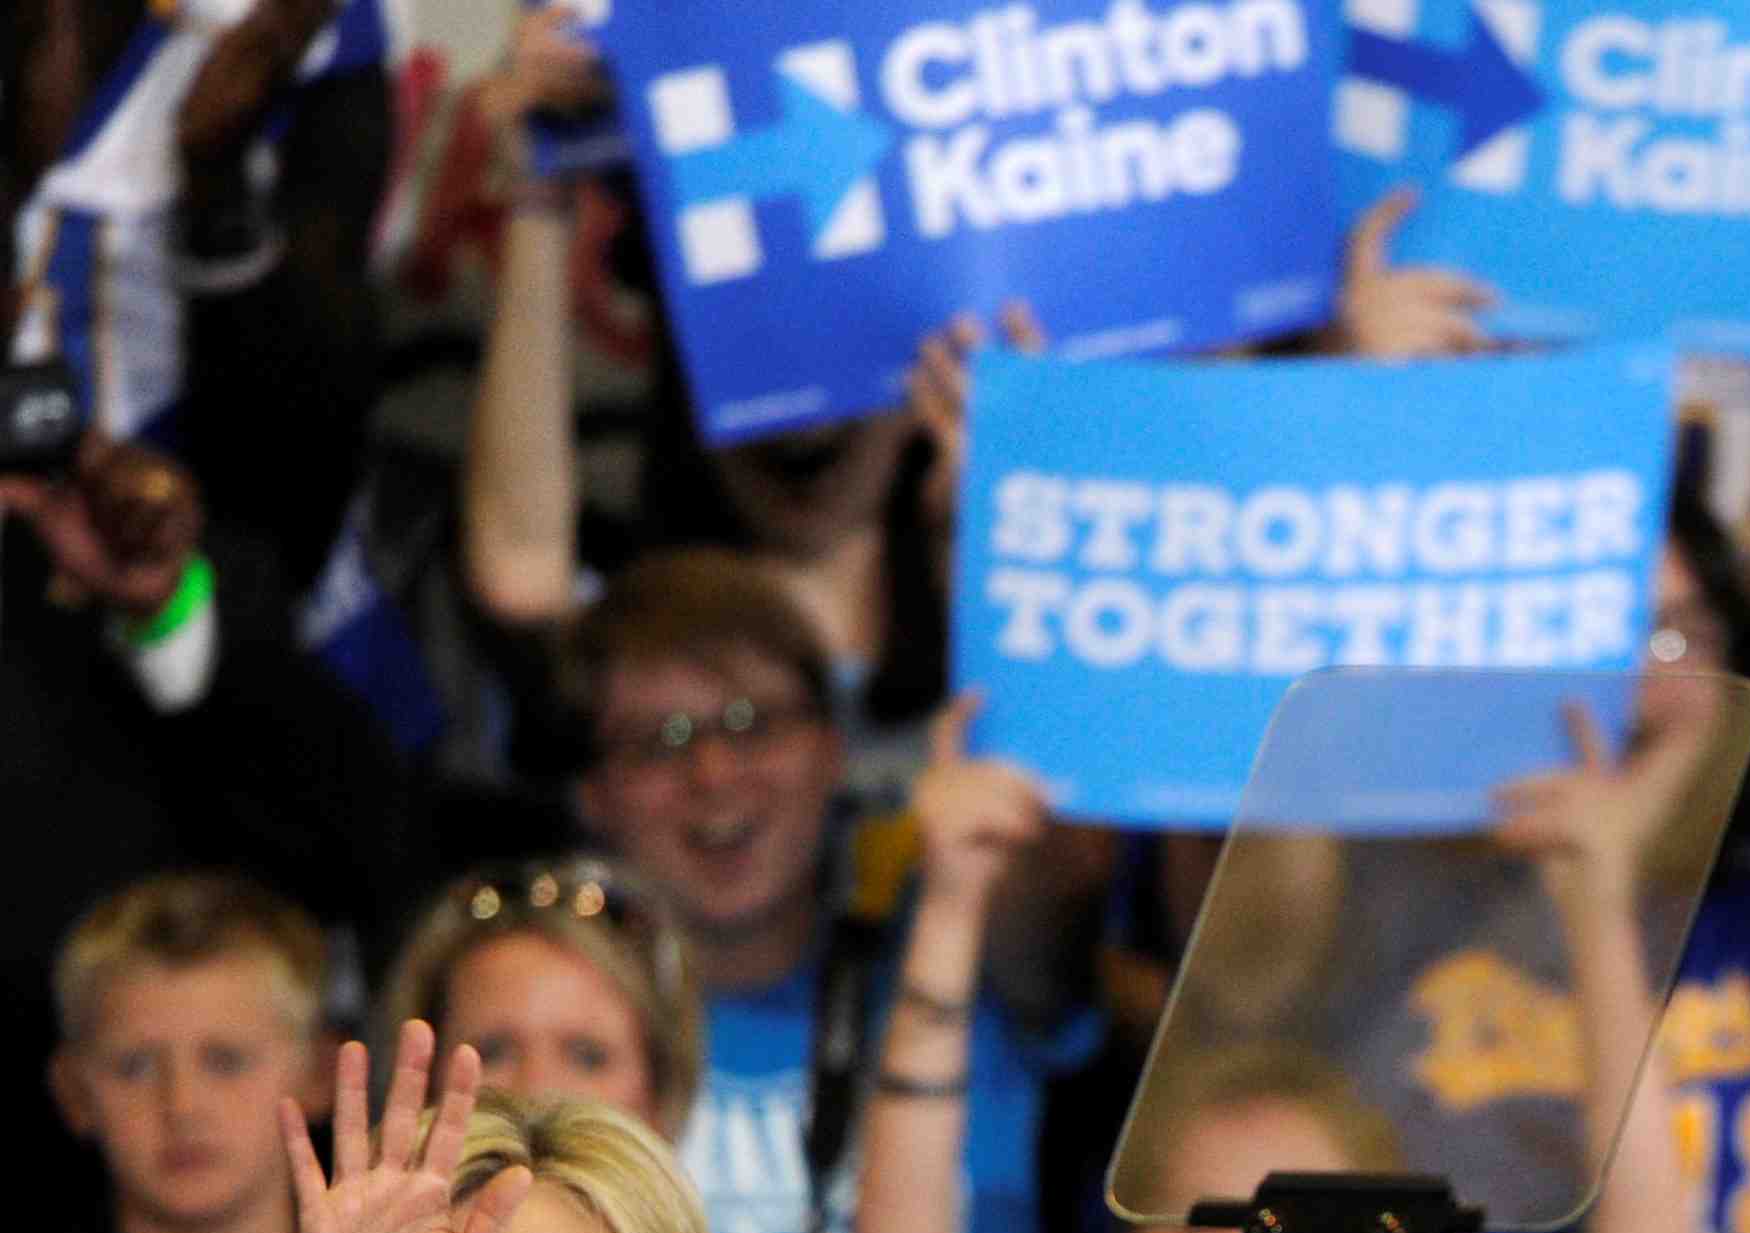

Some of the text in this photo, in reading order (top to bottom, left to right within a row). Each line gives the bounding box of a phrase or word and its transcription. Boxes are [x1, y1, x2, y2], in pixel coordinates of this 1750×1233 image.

[879, 0, 1310, 130] Clinton
[903, 104, 1244, 240] Kaine
[991, 469, 1643, 577] STRONGER
[988, 568, 1636, 676] TOGETHER
